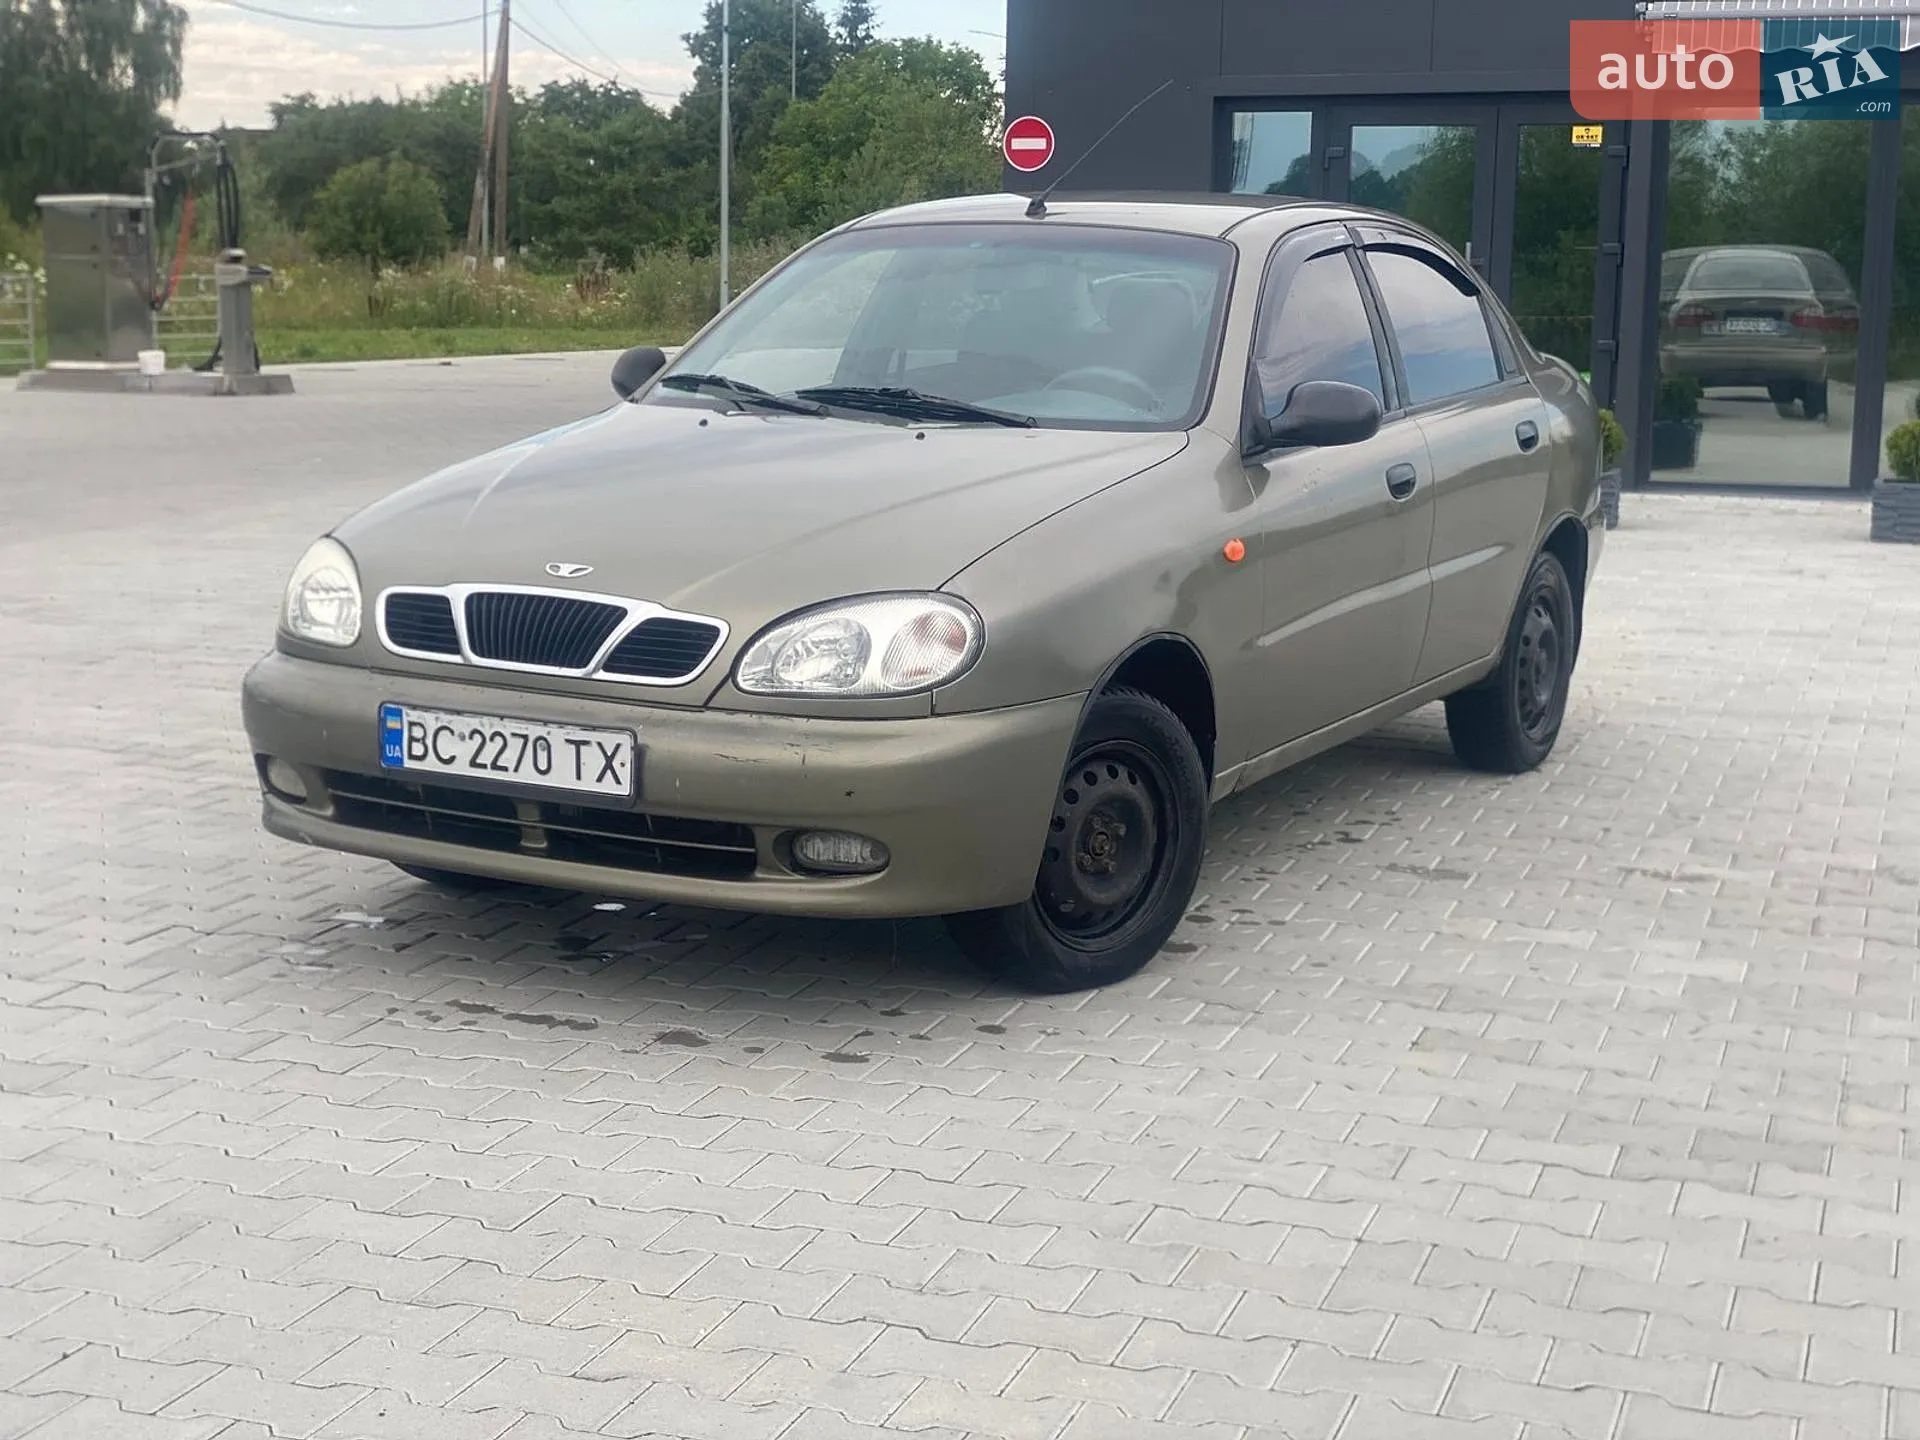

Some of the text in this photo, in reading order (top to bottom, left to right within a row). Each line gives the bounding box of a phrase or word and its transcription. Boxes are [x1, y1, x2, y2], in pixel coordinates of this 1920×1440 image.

[386, 744, 402, 758] UA
[406, 720, 623, 785] BC 2270 TX
